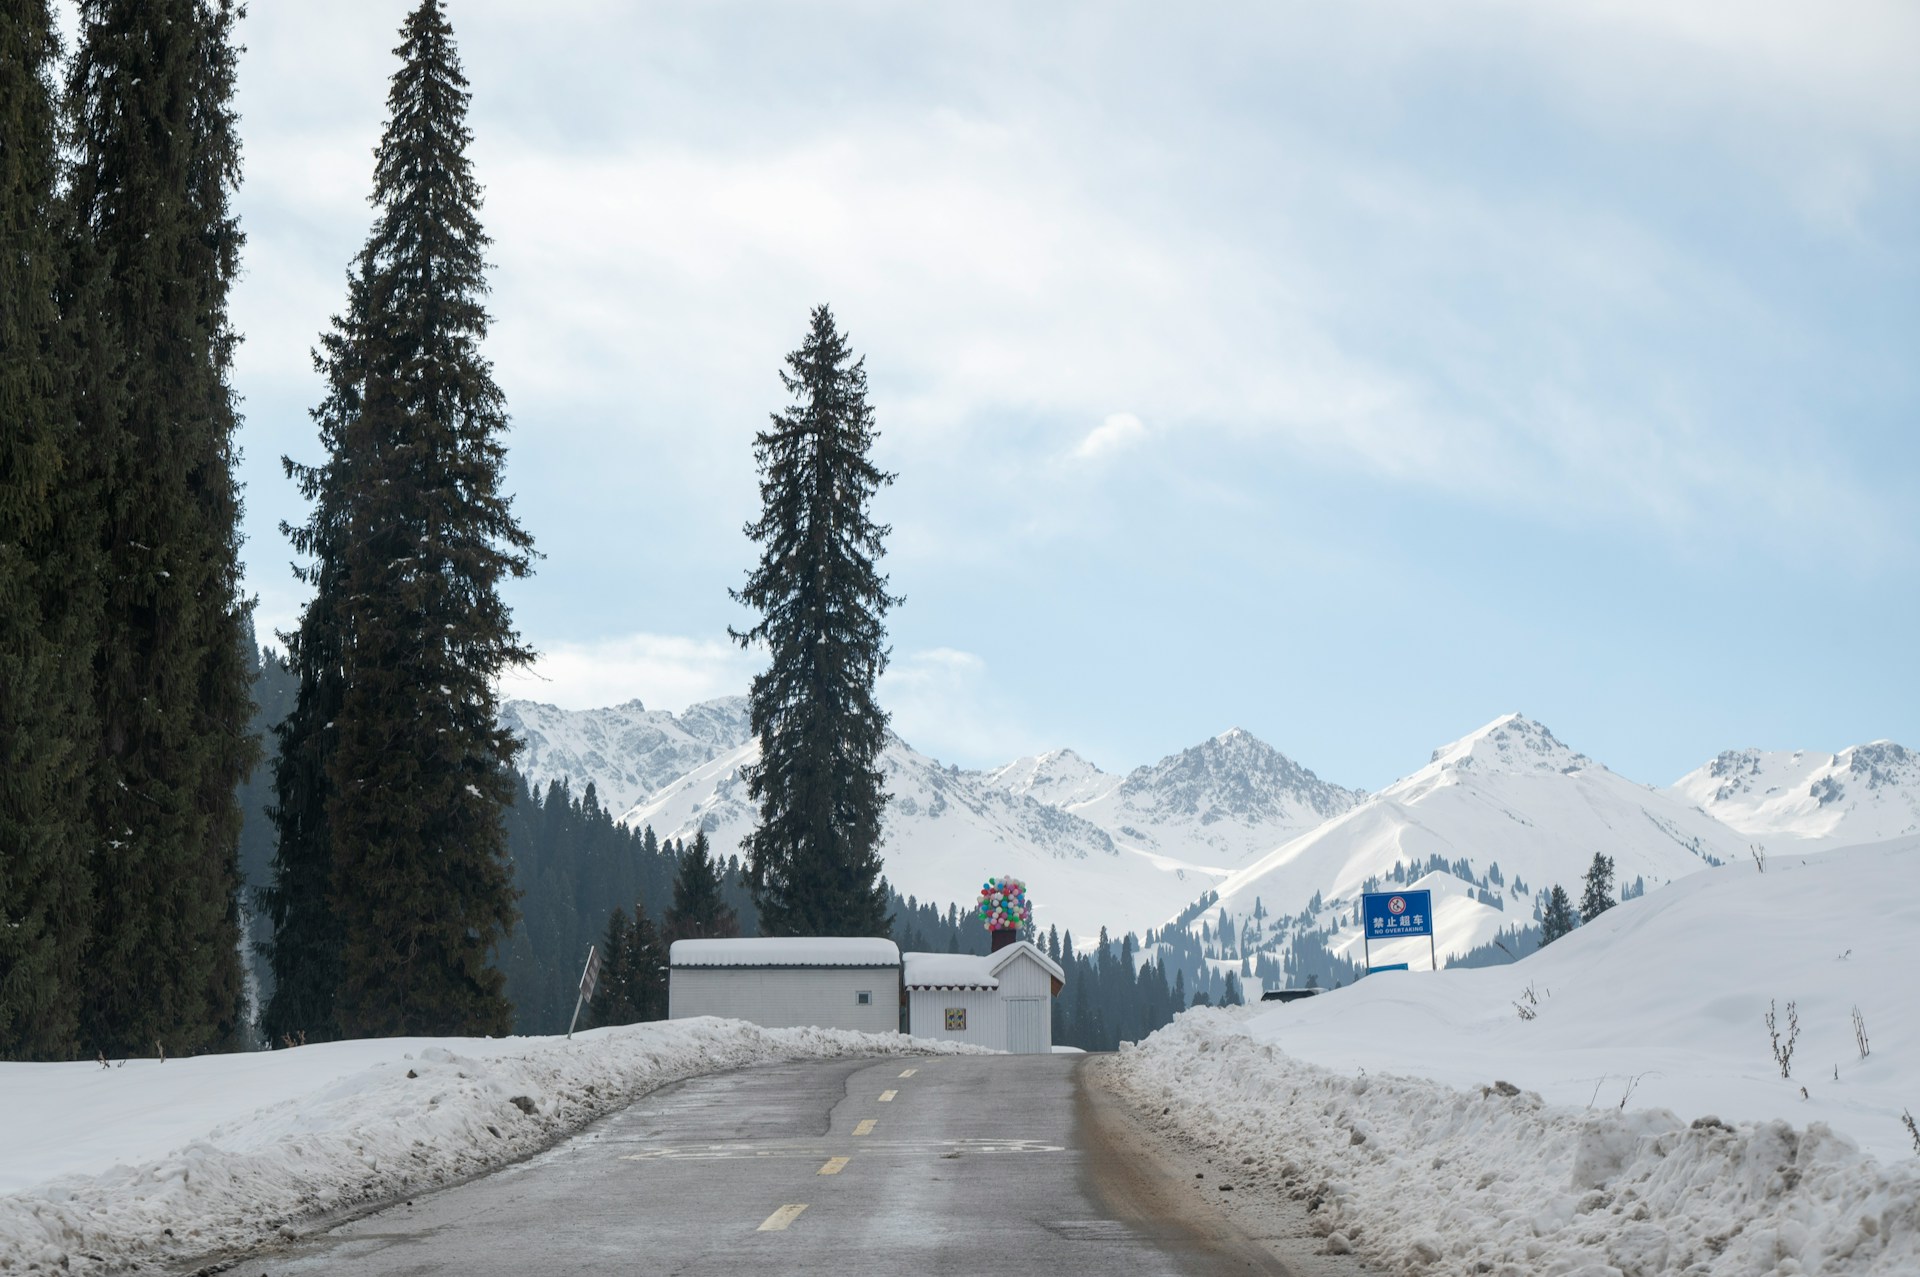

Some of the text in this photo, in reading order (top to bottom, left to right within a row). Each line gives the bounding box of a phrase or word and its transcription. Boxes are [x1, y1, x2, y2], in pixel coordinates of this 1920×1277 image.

[1372, 914, 1424, 928] 禁止超车
[1385, 926, 1424, 934] OVERTAKING
